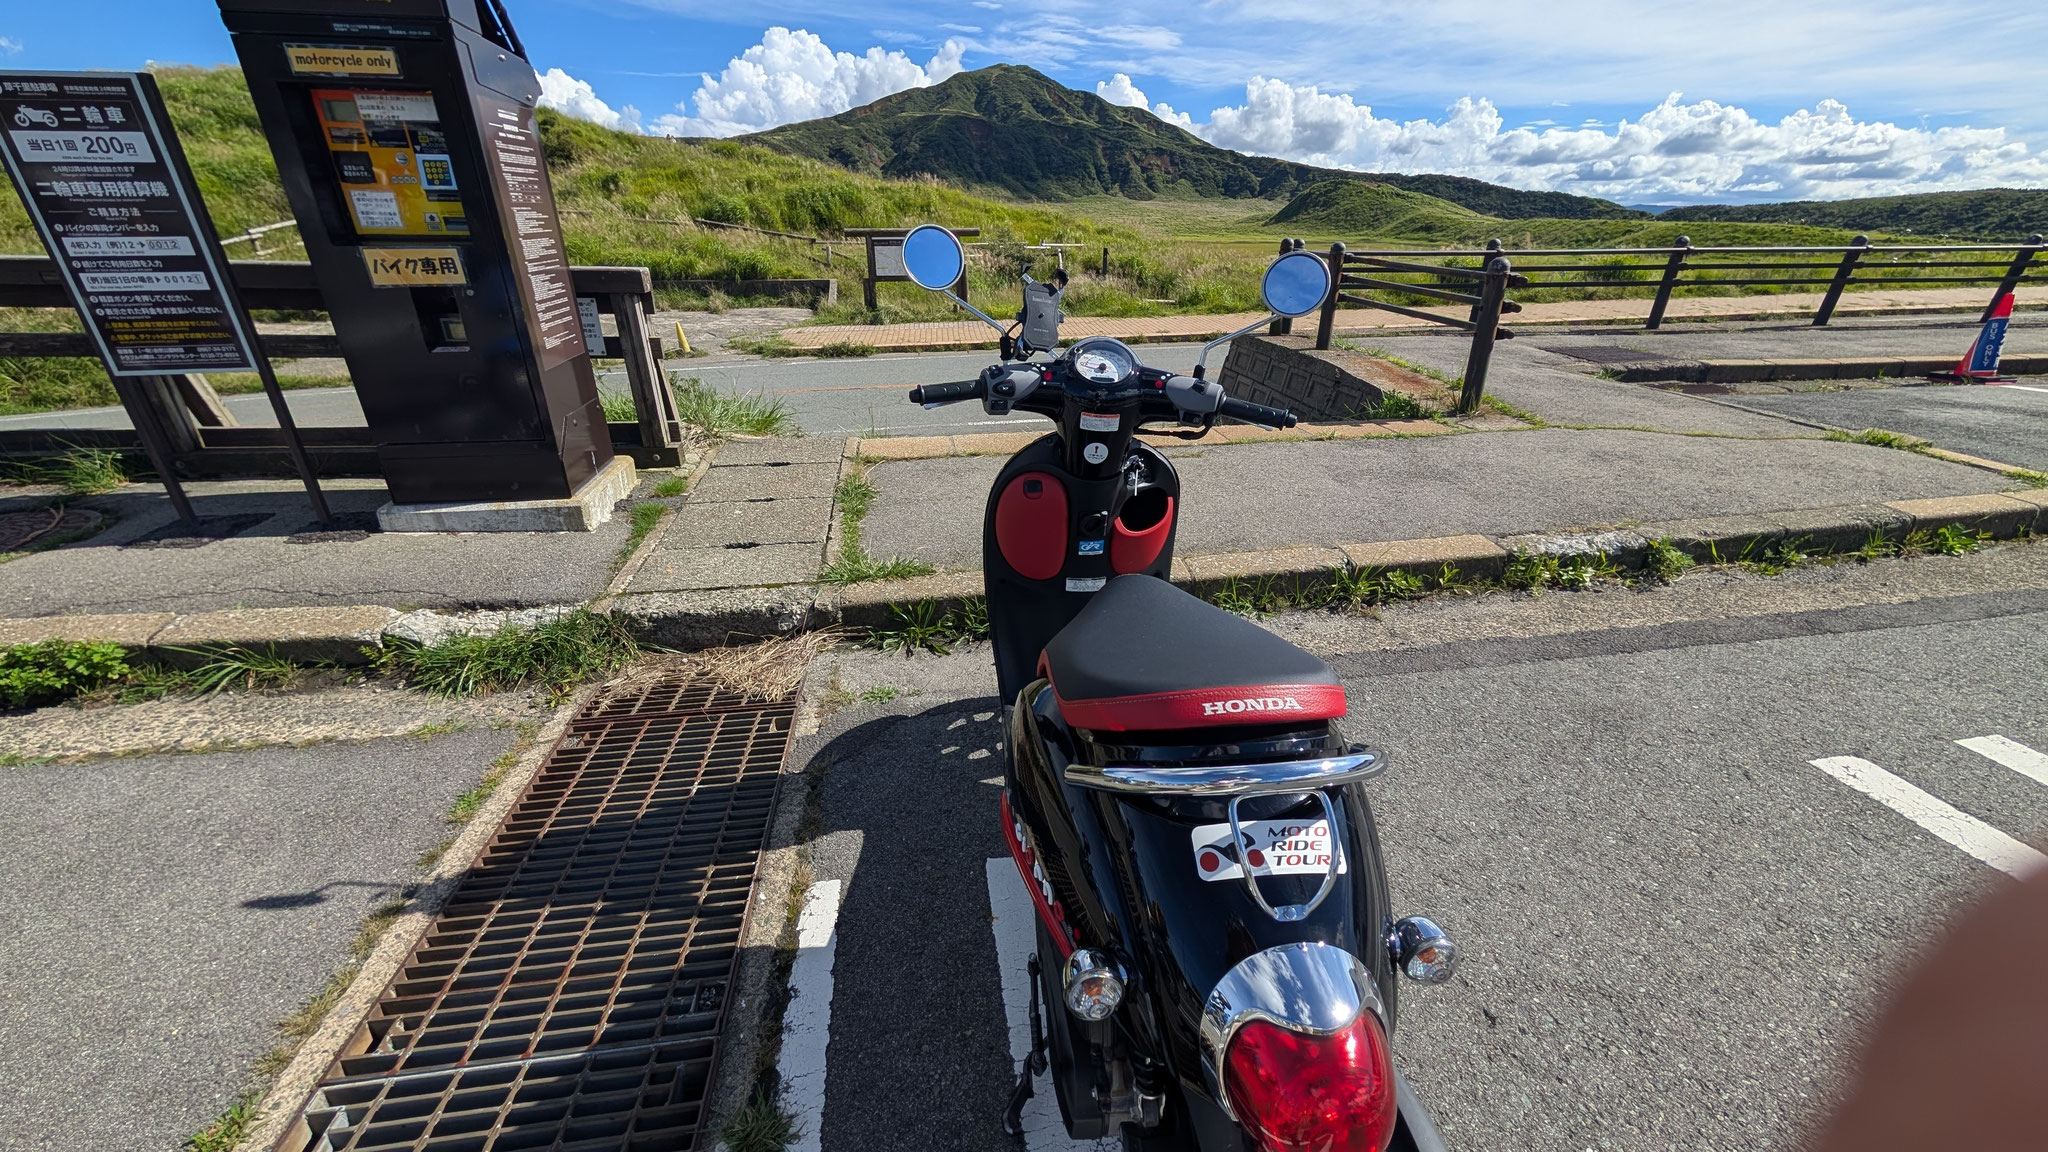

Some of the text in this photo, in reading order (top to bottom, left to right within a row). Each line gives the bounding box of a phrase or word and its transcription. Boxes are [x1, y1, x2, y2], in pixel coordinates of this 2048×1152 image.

[295, 54, 391, 67] motorcycle only
[59, 105, 126, 123] 二輪車
[27, 136, 137, 154] 当日1回 200円
[36, 181, 169, 197] 二輪車専用精算機
[87, 207, 141, 217] ご精算方法
[373, 257, 459, 275] バイク専用
[1989, 323, 1998, 340] BUS
[1983, 344, 1994, 367] ONLY
[1202, 697, 1304, 716] HONDA
[1267, 826, 1327, 838] MOTO
[1271, 840, 1323, 852] RIDE
